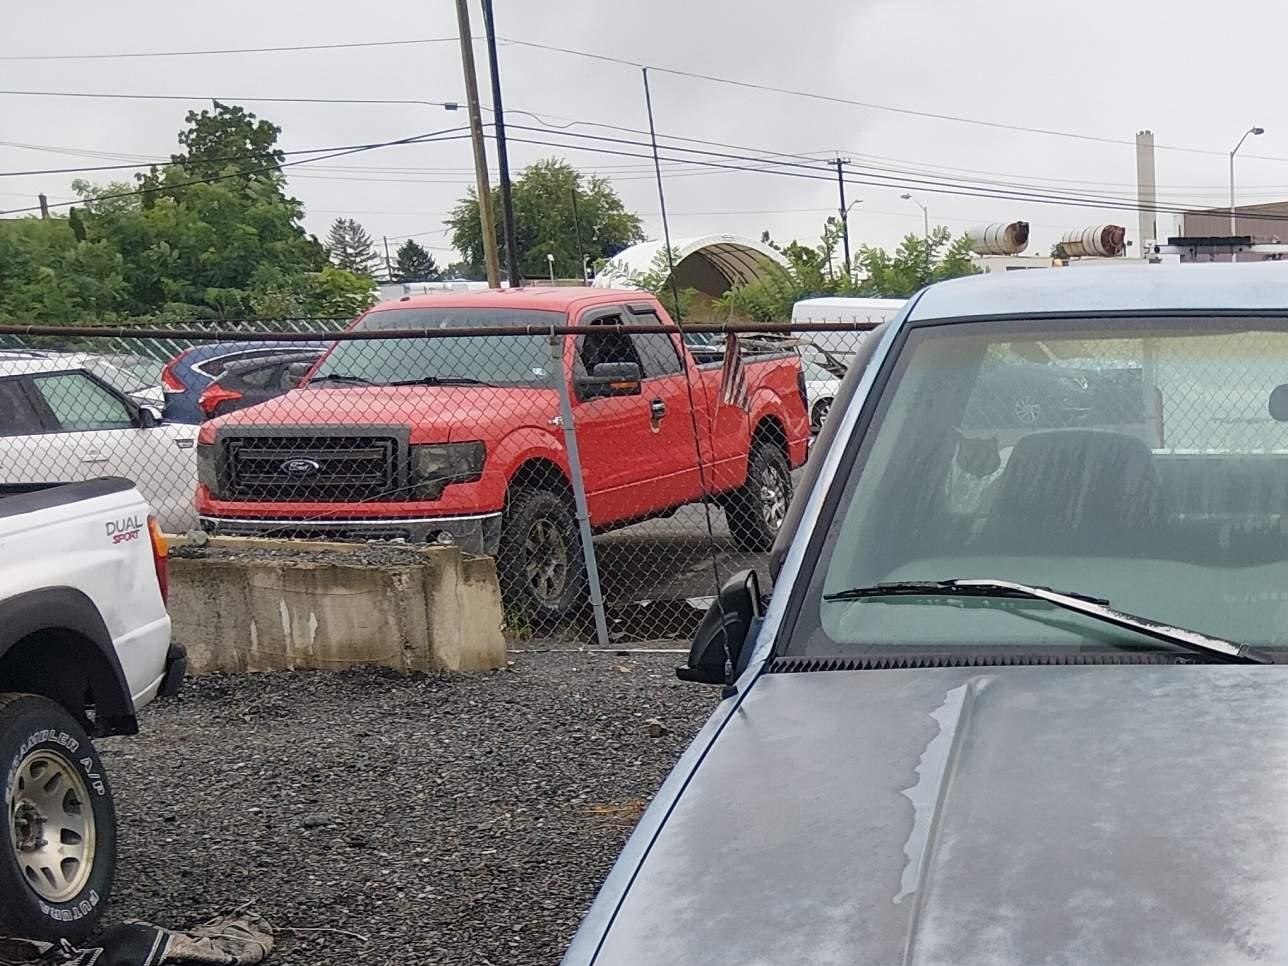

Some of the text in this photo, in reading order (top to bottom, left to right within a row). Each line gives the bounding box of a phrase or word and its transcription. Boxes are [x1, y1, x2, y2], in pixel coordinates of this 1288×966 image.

[105, 515, 143, 537] DUAL
[112, 529, 141, 544] SPORT
[80, 756, 106, 796] A/P
[38, 889, 100, 922] FUTURA
